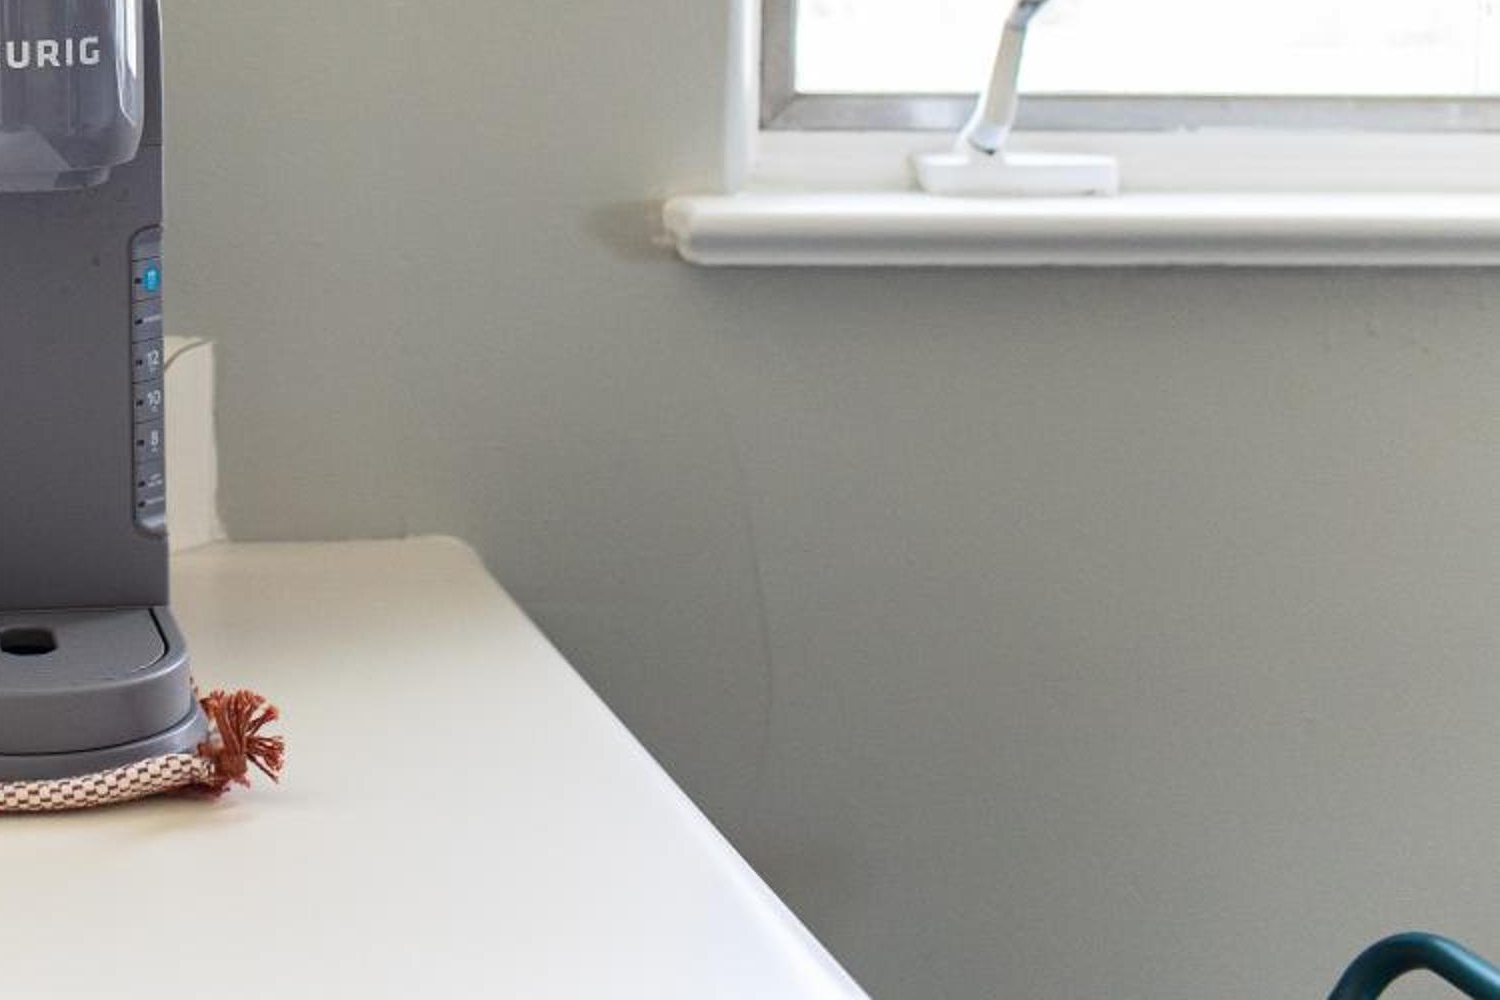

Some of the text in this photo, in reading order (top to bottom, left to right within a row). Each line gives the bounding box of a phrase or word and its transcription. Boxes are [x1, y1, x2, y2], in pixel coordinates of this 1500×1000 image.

[147, 349, 159, 365] 12
[147, 389, 161, 405] 10
[151, 430, 159, 445] 8
